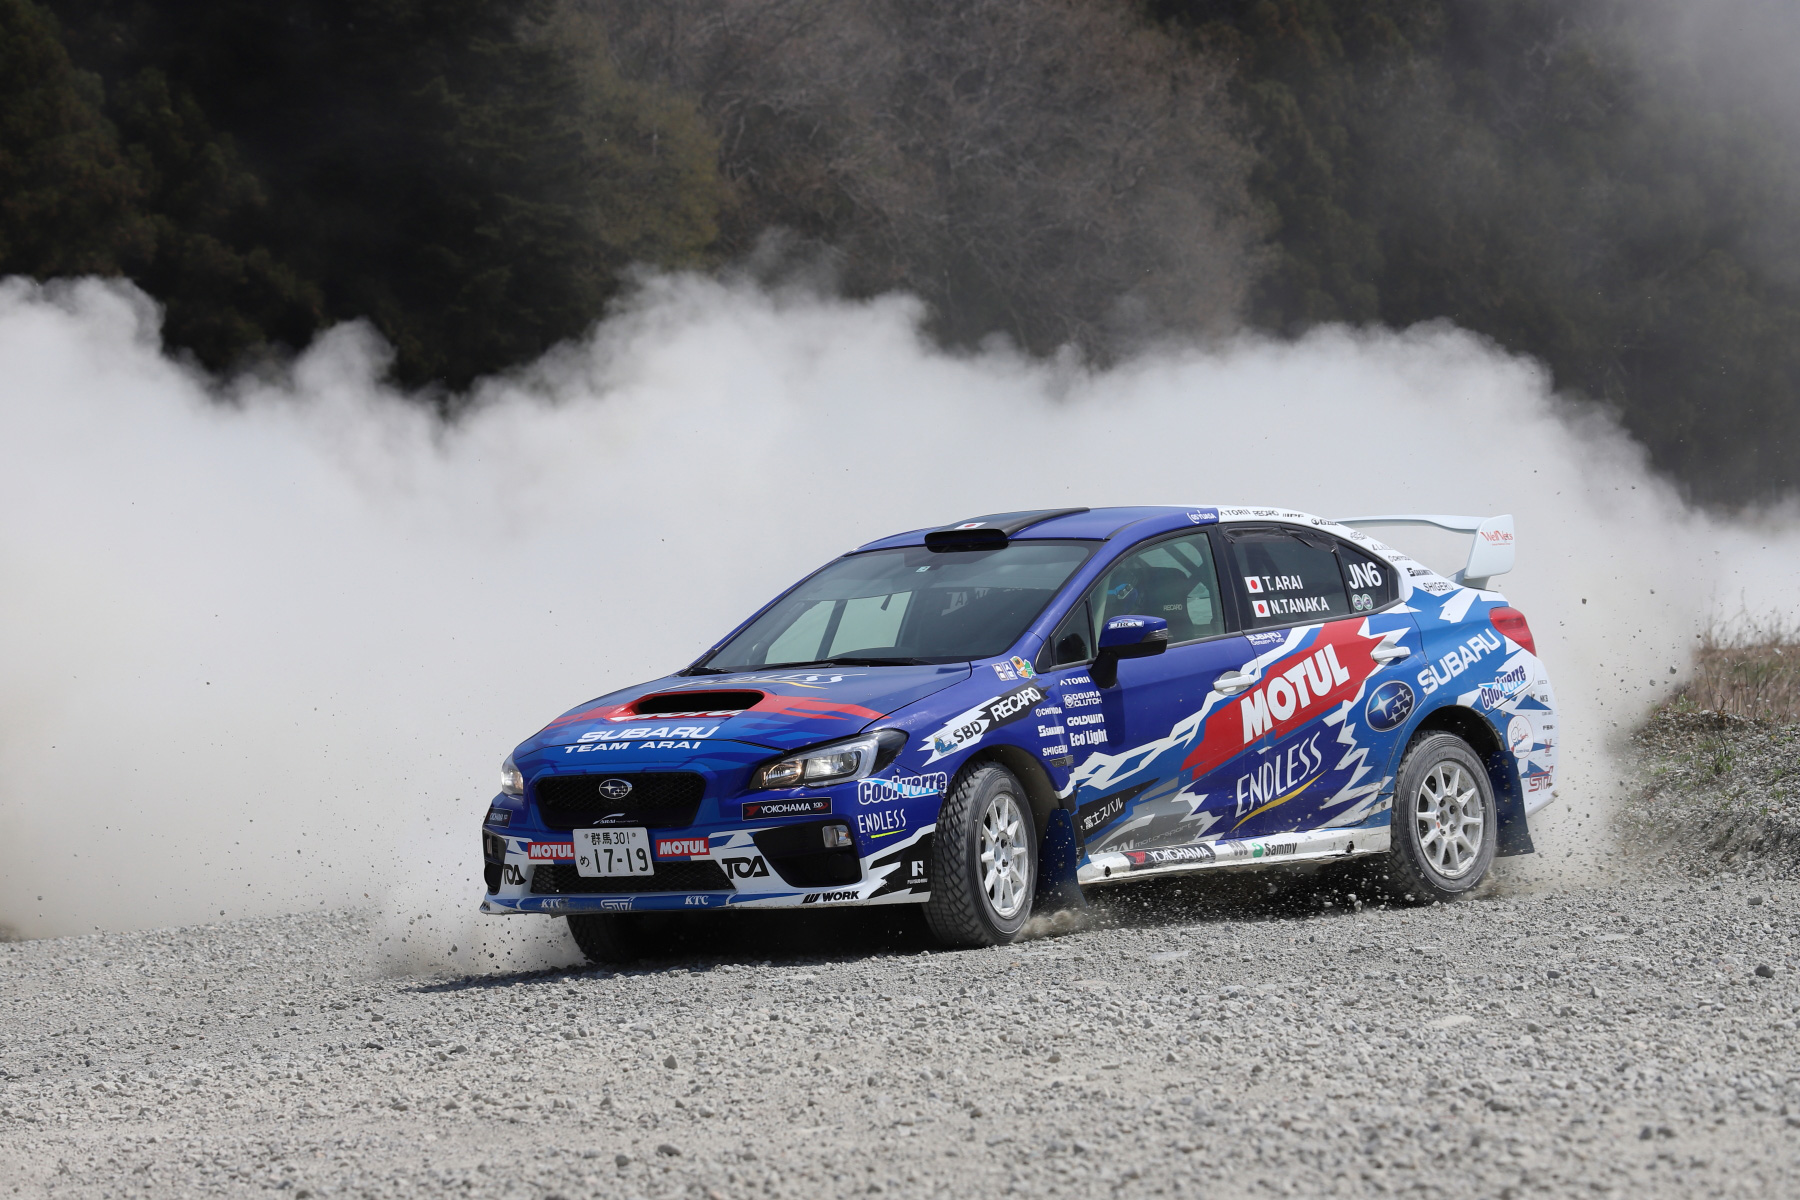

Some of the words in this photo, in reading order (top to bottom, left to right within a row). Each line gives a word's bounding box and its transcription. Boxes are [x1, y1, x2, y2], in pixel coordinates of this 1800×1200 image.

[1349, 562, 1382, 590] JN6
[1270, 597, 1330, 615] N.TANAKA
[1246, 632, 1281, 641] SUBARU
[1417, 628, 1501, 695] SUBARU
[1073, 690, 1101, 700] OGURA
[1240, 643, 1350, 744] MOTUL
[990, 686, 1041, 721] RECARO
[1074, 697, 1102, 707] CLUTCH
[577, 726, 720, 743] SUBARU
[953, 721, 983, 743] SBD
[564, 742, 629, 753] TEAM
[638, 741, 702, 750] ARAI
[1234, 730, 1323, 819] ENDLESS
[761, 802, 811, 814] YOKOHAMA
[857, 808, 907, 834] ENDLESS
[530, 844, 574, 858] MOTUL
[659, 840, 707, 855] MOTUL
[1146, 846, 1211, 862] YOKOHAMA
[1264, 842, 1298, 857] Sammy
[580, 855, 590, 868] め
[594, 847, 649, 873] 17-19
[684, 895, 709, 905] KTC
[822, 890, 860, 903] WORK
